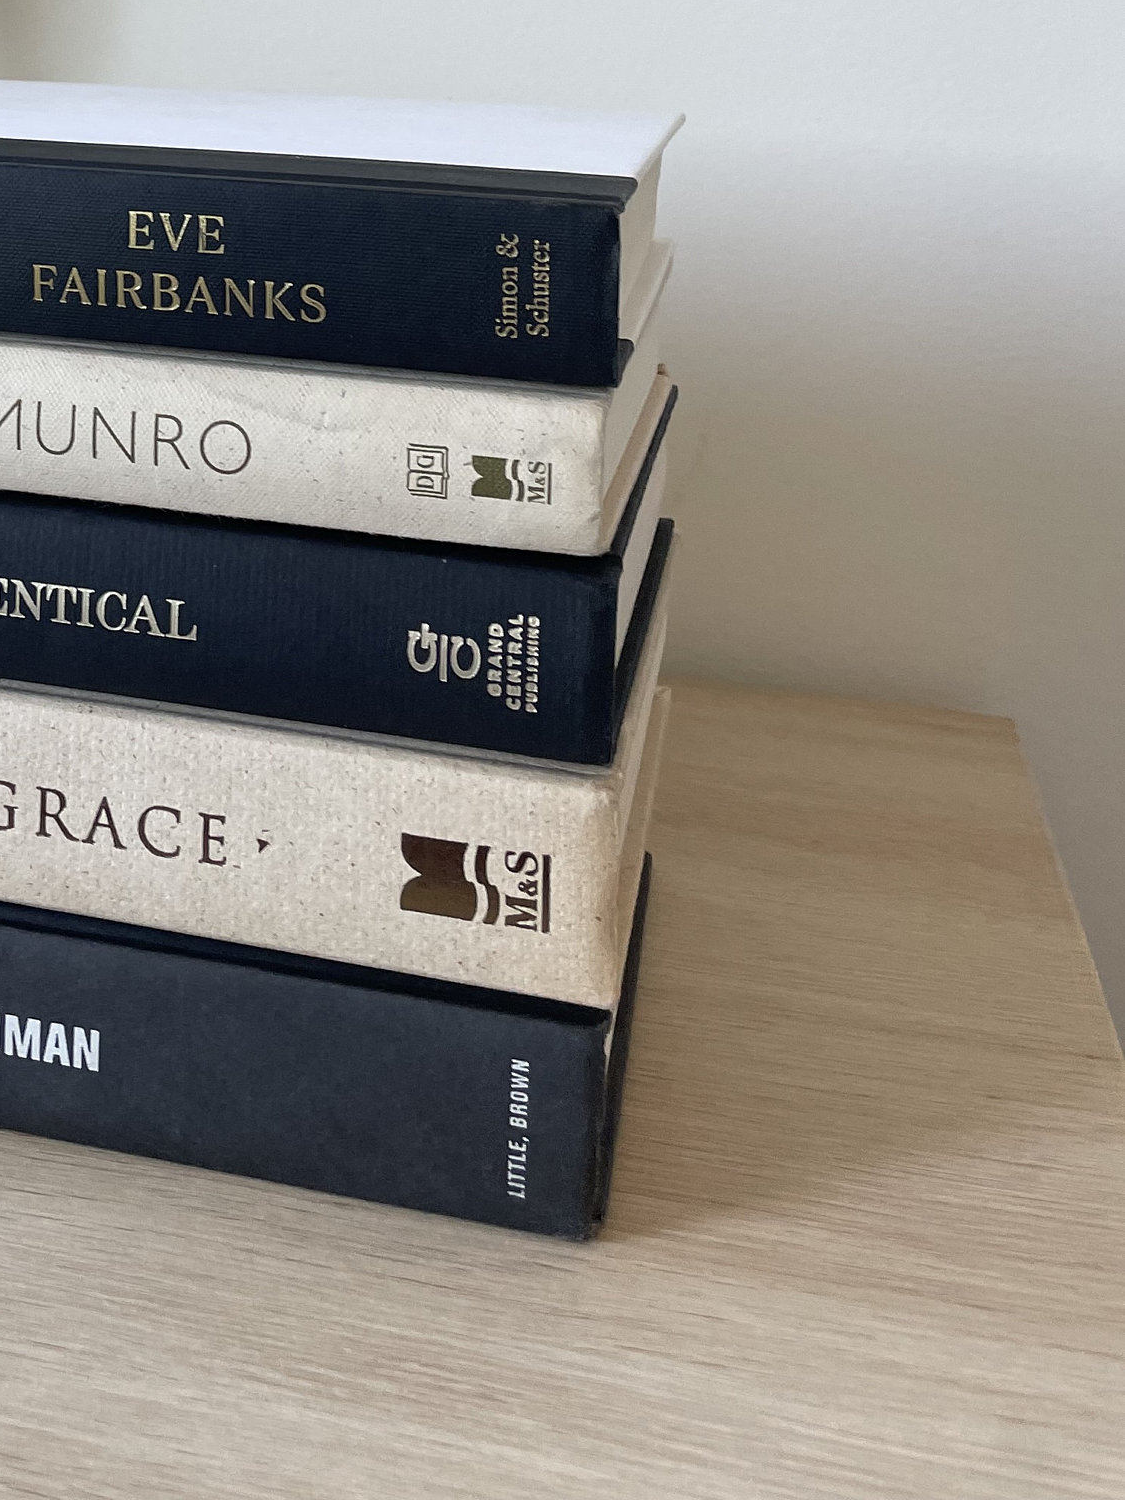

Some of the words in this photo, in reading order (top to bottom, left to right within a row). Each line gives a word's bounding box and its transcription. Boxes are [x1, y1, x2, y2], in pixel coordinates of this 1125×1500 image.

[127, 211, 225, 255] EVE
[495, 233, 520, 258] &
[32, 264, 328, 323] FAIRBANKS
[495, 266, 519, 339] Simon
[526, 239, 551, 338] Schuster
[487, 622, 504, 697] GRAND
[506, 613, 524, 711] CENTRAL
[525, 615, 541, 714] PUBLISHING
[504, 850, 539, 932] M&S
[509, 1058, 530, 1129] BROWN
[507, 1136, 530, 1199] LITTLE,
